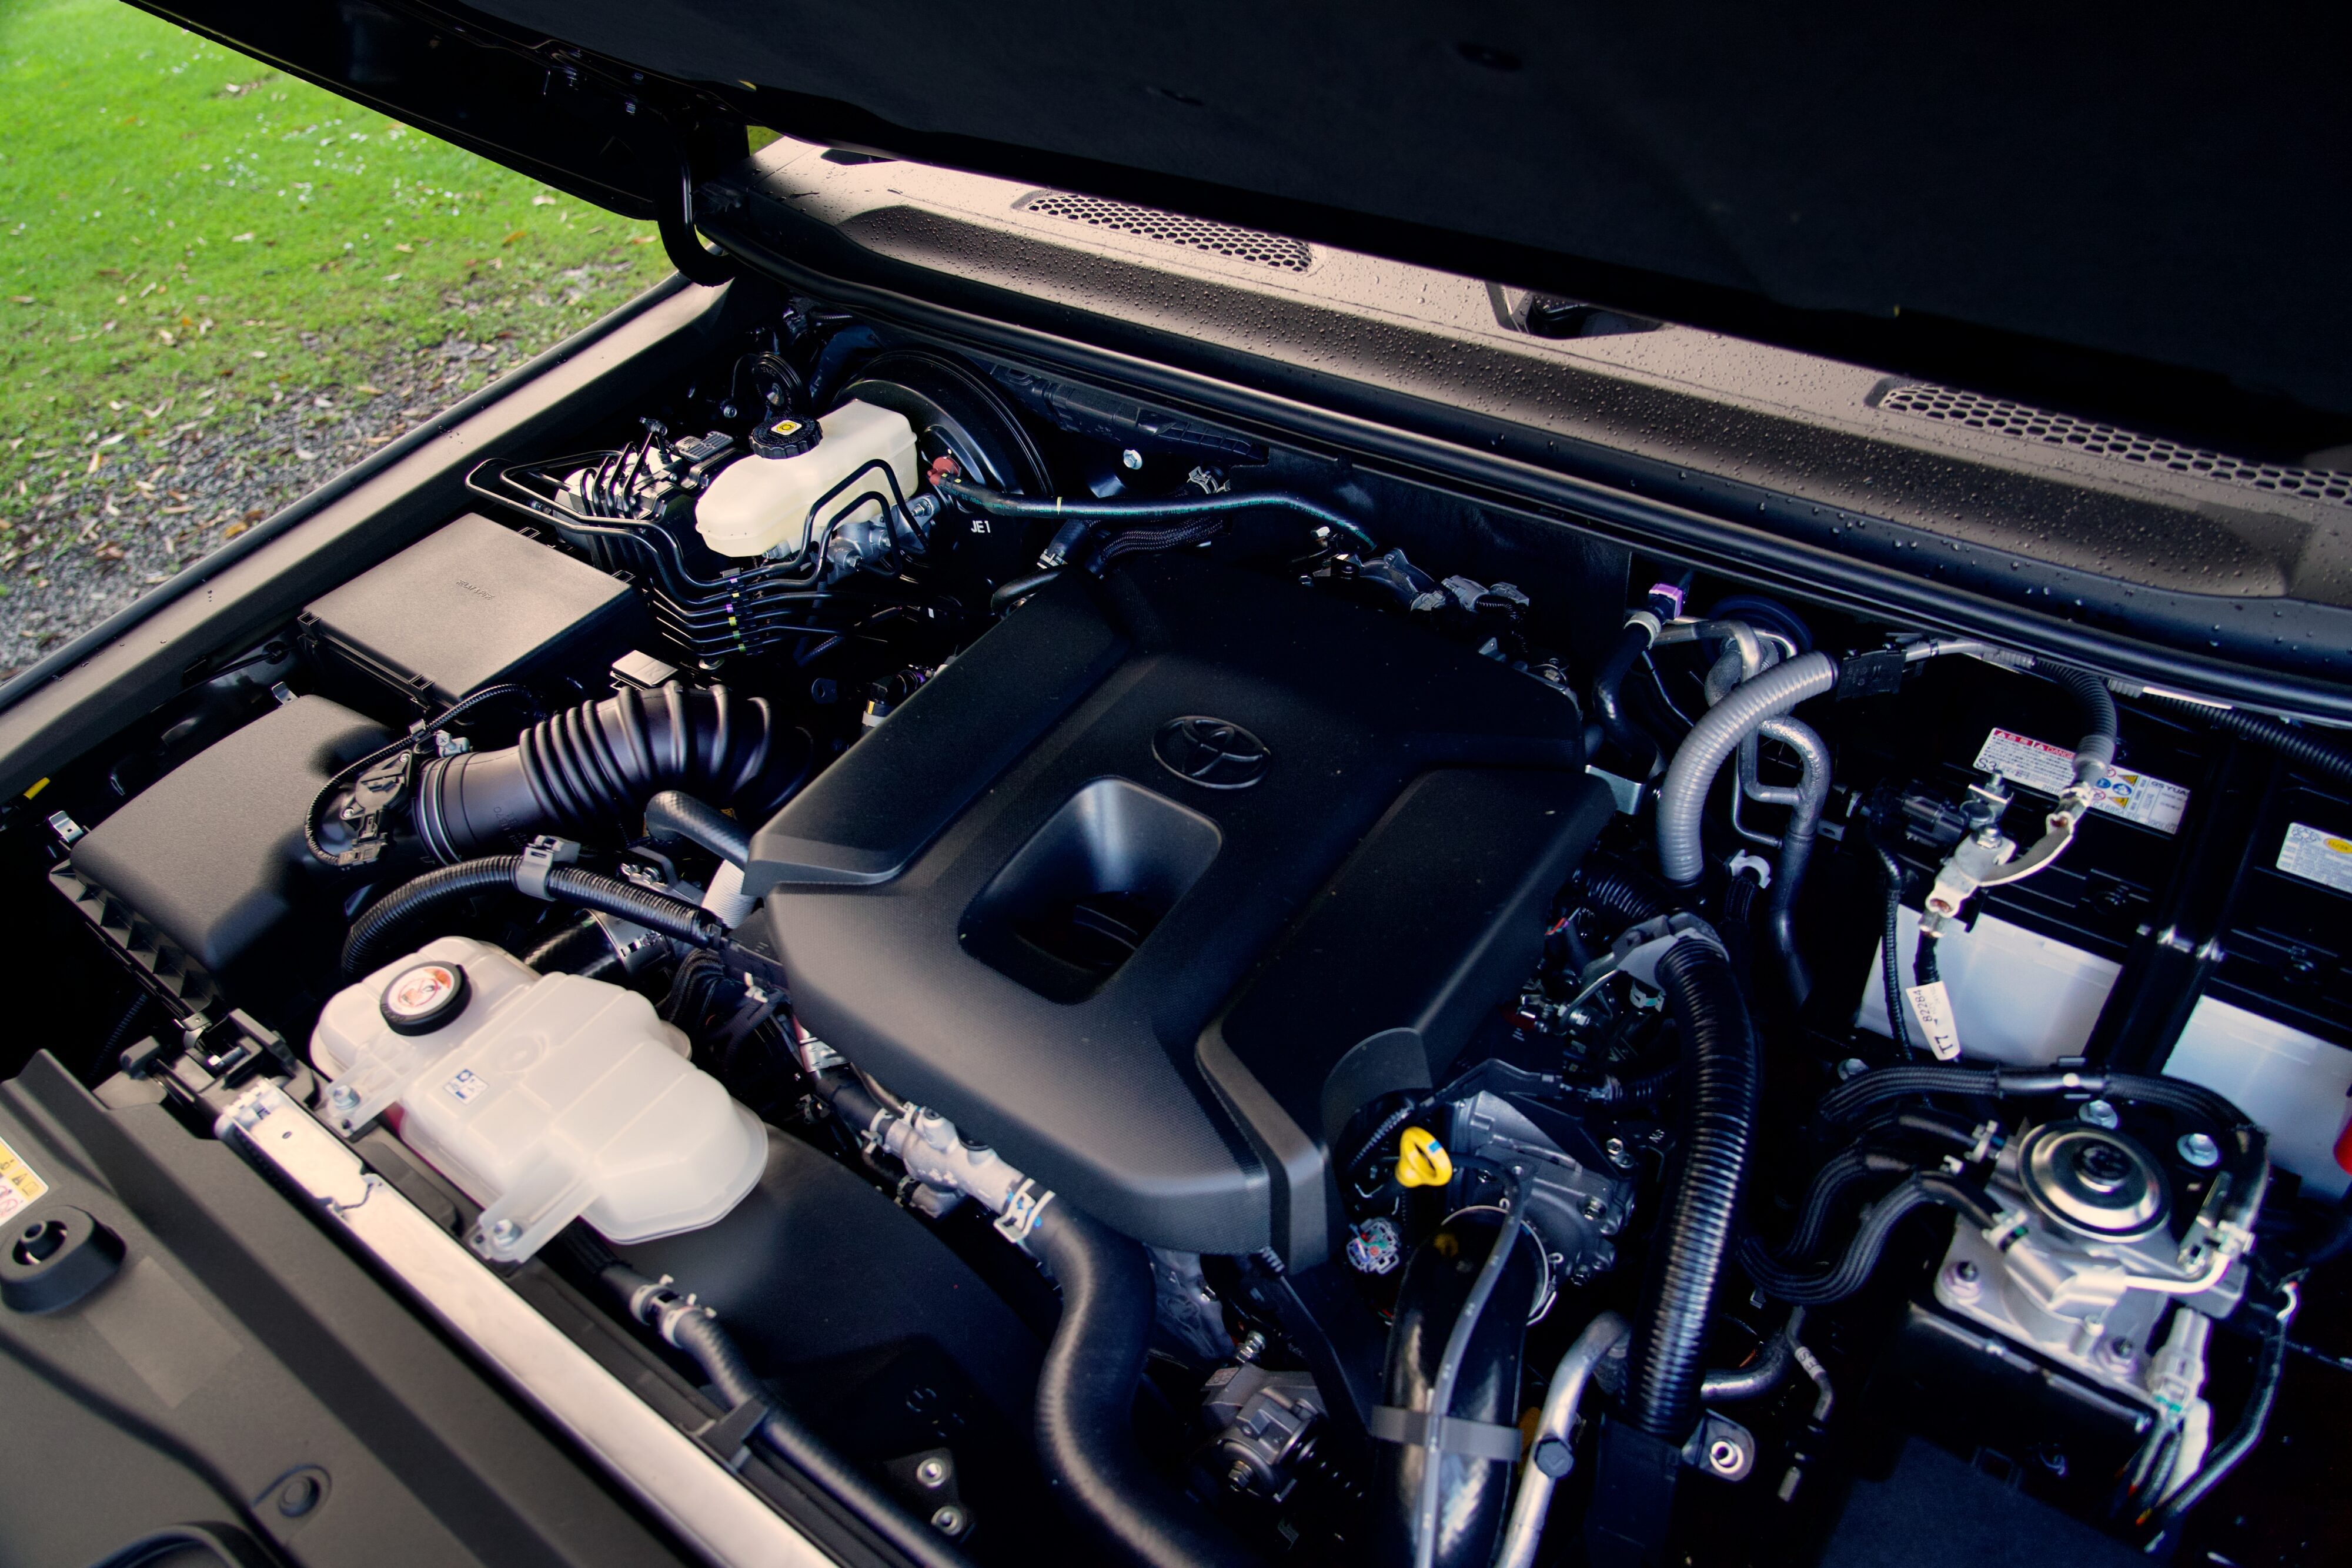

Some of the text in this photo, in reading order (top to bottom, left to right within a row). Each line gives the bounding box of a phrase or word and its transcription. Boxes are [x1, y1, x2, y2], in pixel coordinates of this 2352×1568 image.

[970, 520, 991, 533] JE1
[456, 580, 477, 591] RELAY
[477, 590, 495, 600] FUSE
[2046, 747, 2076, 760] DANGE
[2151, 781, 2189, 796] GS YUA
[1913, 989, 1932, 1022] 82284
[1935, 1035, 1953, 1054] T7
